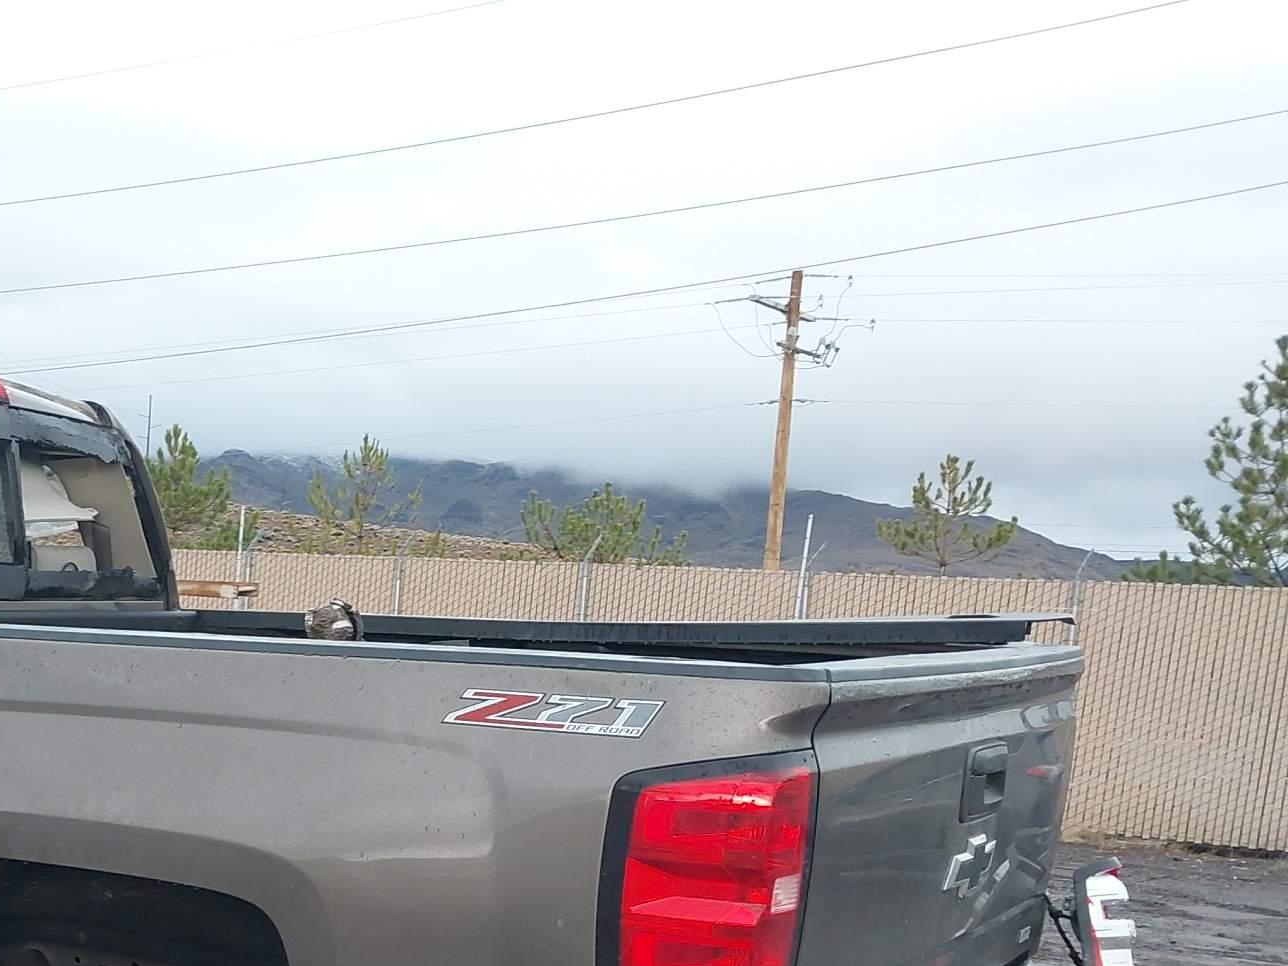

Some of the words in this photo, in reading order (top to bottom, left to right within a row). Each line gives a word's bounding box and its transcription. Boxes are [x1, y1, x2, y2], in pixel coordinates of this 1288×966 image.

[442, 688, 666, 736] Z71
[566, 724, 595, 732] OFF
[598, 726, 640, 735] ROAD
